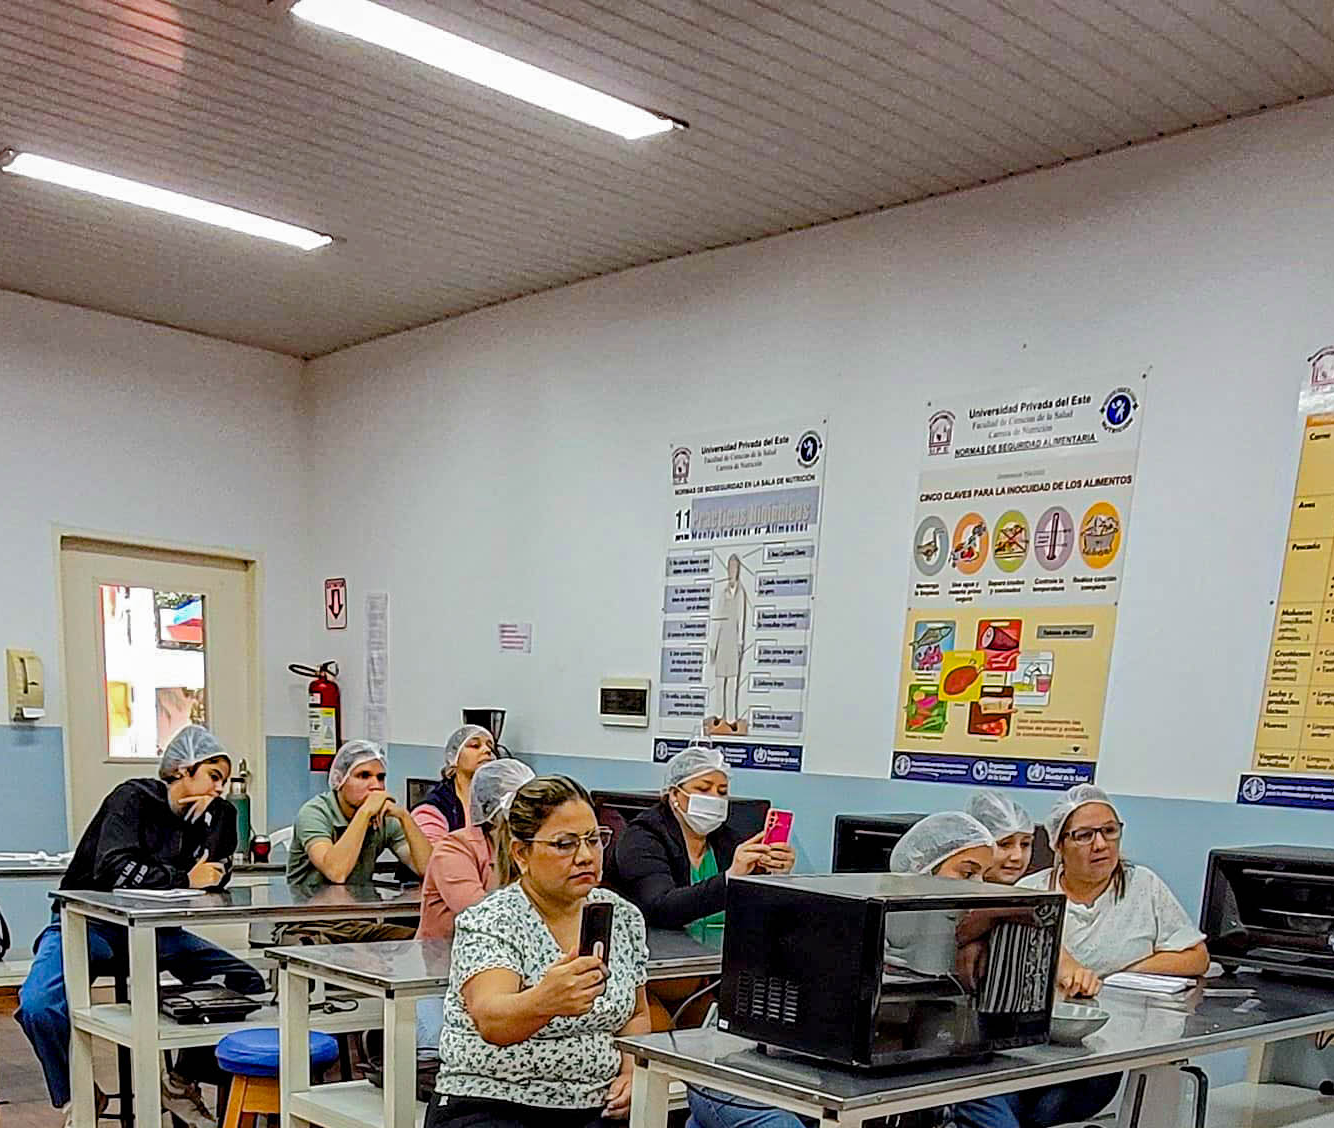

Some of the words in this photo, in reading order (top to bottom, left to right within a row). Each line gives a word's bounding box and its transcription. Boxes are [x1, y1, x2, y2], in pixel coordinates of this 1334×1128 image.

[969, 403, 1019, 420] Universidad
[1020, 399, 1053, 412] Privada
[1055, 396, 1069, 408] del
[1071, 394, 1092, 406] Este
[700, 442, 738, 455] Universidad
[738, 439, 762, 450] Privada
[763, 437, 774, 447] del
[774, 435, 789, 445] Este
[955, 445, 986, 458] NORMAS
[987, 443, 997, 455] DE
[998, 438, 1042, 453] SEGURIDAD
[1042, 432, 1097, 448] ALIMENTARIA
[752, 480, 760, 488] LA
[761, 478, 776, 487] SALA
[776, 477, 784, 485] DE
[785, 473, 815, 484] NUTRICIÓN
[919, 491, 943, 503] CINCO
[943, 488, 972, 501] CLAVES
[972, 487, 994, 499] PARA
[995, 485, 1007, 496] LA
[1007, 482, 1051, 495] INOCUIDAD
[1051, 480, 1064, 491] DE
[1065, 479, 1082, 490] LOS
[1083, 474, 1132, 488] ALIMENTOS
[675, 509, 690, 529] 11
